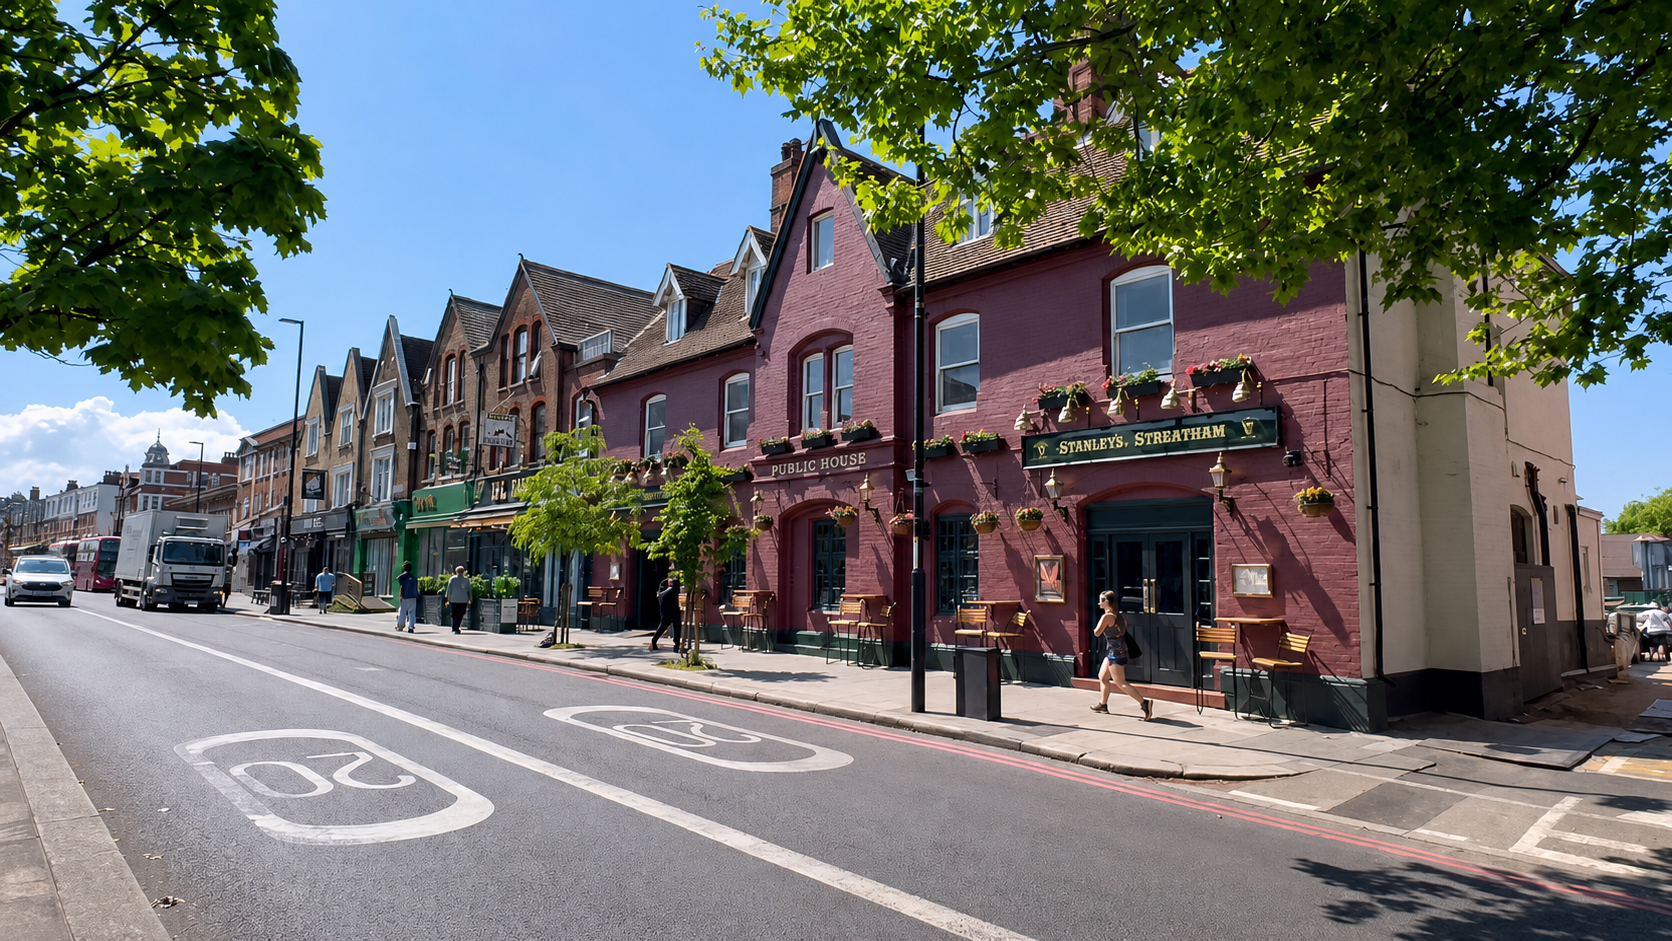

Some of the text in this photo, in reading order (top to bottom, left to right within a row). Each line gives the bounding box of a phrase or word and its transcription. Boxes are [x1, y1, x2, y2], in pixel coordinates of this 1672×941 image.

[1134, 424, 1226, 448] STREATHAM
[771, 452, 866, 477] PUBLIC HOUSE
[229, 752, 417, 798] 20
